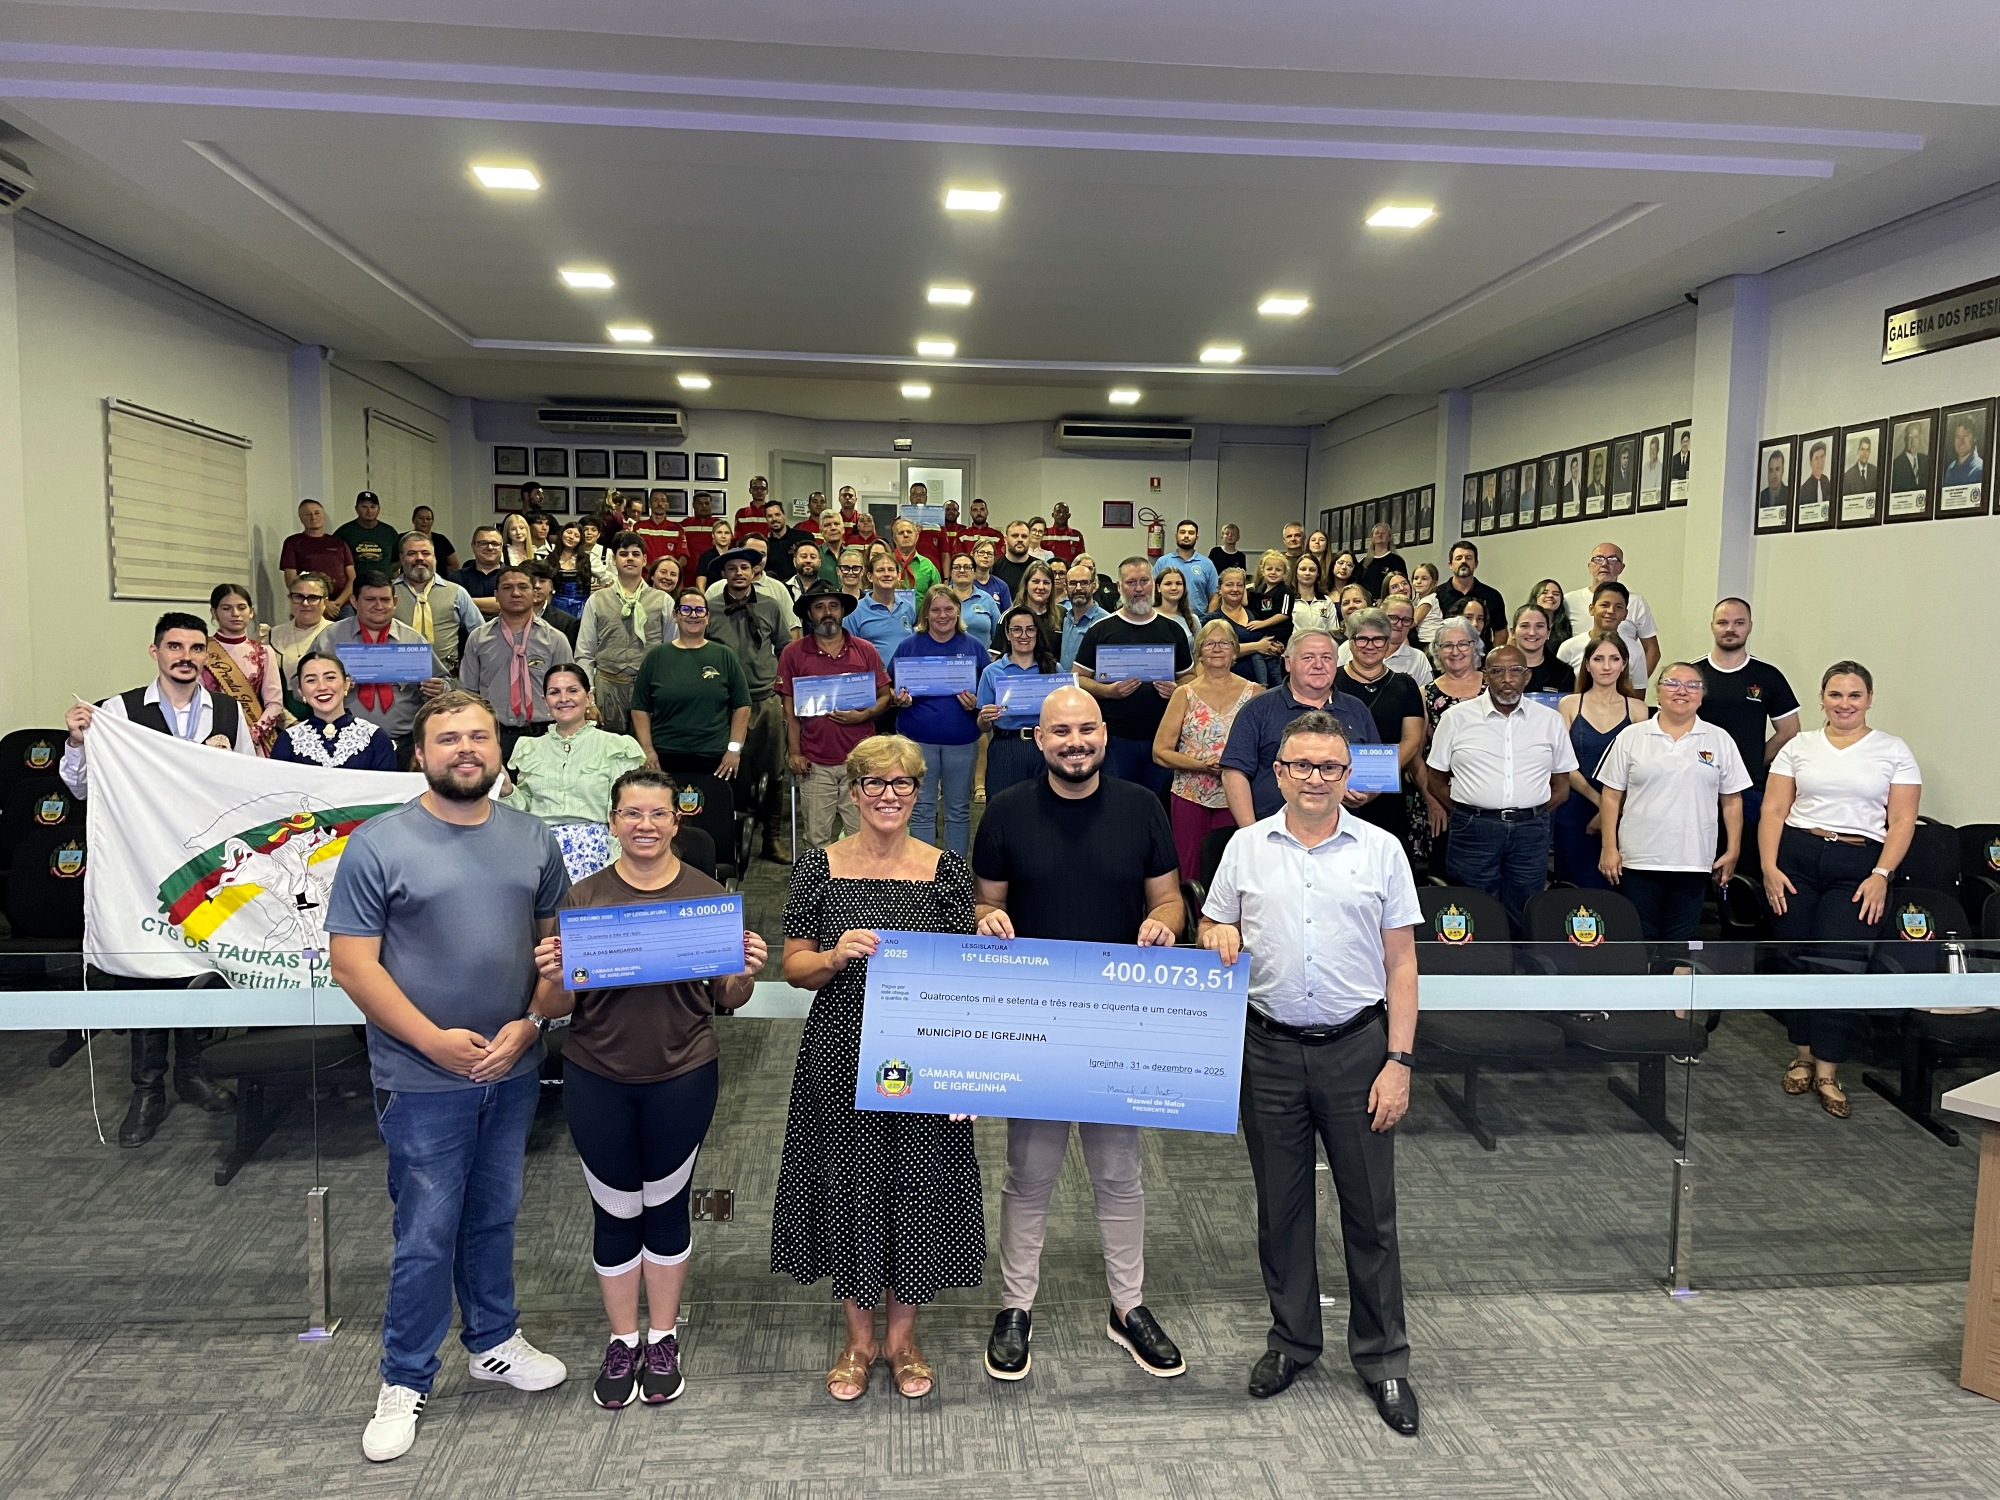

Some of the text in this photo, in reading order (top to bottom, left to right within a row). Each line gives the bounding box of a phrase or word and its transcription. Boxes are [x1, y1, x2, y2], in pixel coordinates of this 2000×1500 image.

[1889, 297, 2000, 342] GALERIA DOS PRESI
[632, 909, 667, 917] LEGISLATURA
[678, 902, 735, 917] 43.000,00
[141, 917, 179, 942] CTG
[183, 935, 210, 953] OS
[216, 942, 300, 969] TAURAS
[961, 943, 1008, 951] LESGISLATURA
[883, 948, 908, 958] 2025
[979, 954, 1050, 966] LEGISLATURA
[1101, 961, 1234, 991] 400.073,51
[919, 991, 980, 1003] Quatrocentos
[982, 994, 996, 1004] mil
[1006, 996, 1039, 1006] setenta
[1049, 998, 1067, 1008] três
[1069, 1000, 1091, 1009] reais
[1101, 1002, 1140, 1012] ciquenta
[1167, 1007, 1208, 1017] centavos
[917, 1027, 972, 1038] MUNICÍPIO
[974, 1030, 989, 1039] DE
[991, 1031, 1047, 1043] IGREJINHA
[1089, 1058, 1124, 1069] Igrejinha
[1130, 1061, 1141, 1070] 31
[1151, 1062, 1193, 1073] dezembro
[918, 1067, 1023, 1082] CÂMARA MUNICIPAL
[933, 1081, 1007, 1093] DE IGREJINHA
[1132, 1105, 1166, 1113] PRESIDENTE
[1164, 1100, 1185, 1108] Matos
